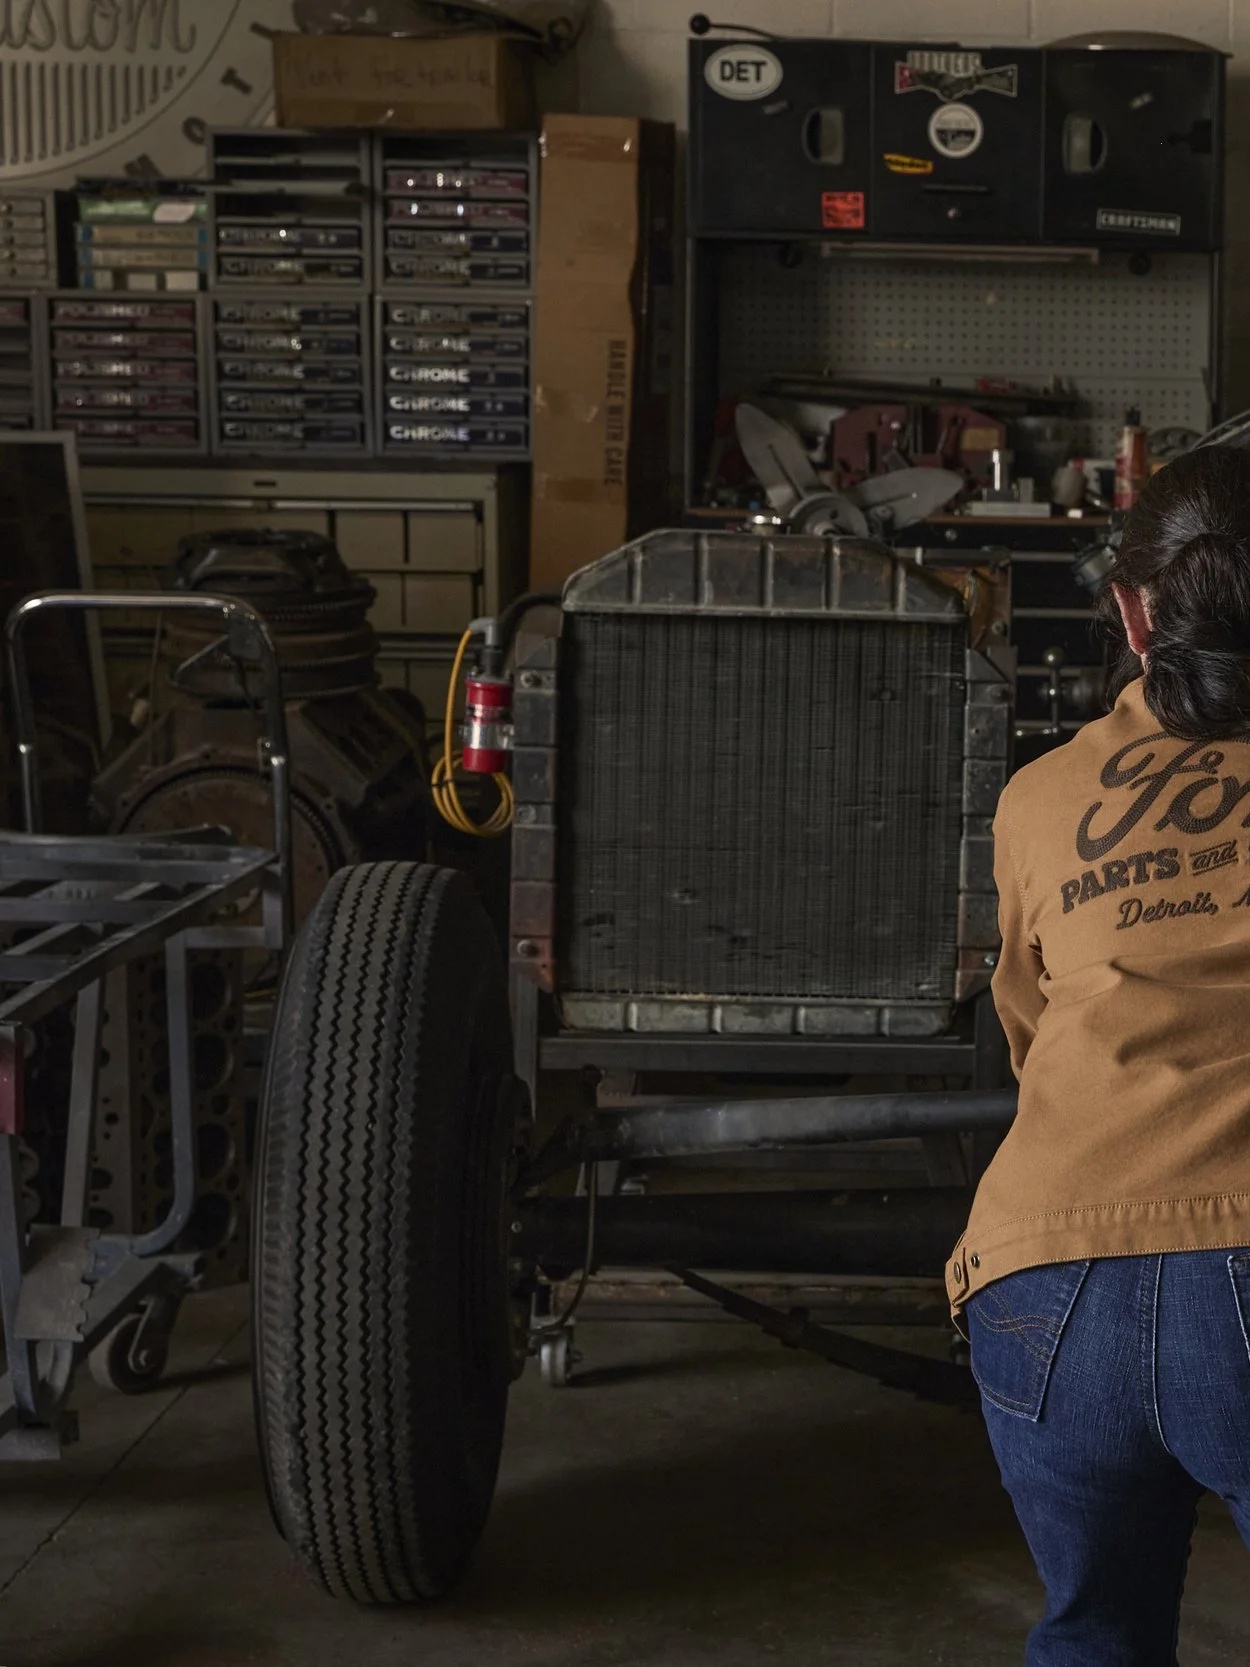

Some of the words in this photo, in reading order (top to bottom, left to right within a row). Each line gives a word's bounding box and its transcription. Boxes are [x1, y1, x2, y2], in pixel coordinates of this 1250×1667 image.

[721, 60, 768, 82] DET
[389, 366, 472, 384] CHROME
[605, 340, 626, 398] HANDLE
[389, 396, 472, 413] CHROME
[389, 424, 472, 442] CHROME
[605, 404, 625, 441] WITH
[603, 448, 624, 485] CARE
[1060, 847, 1181, 914] PARTS
[1189, 843, 1239, 875] and
